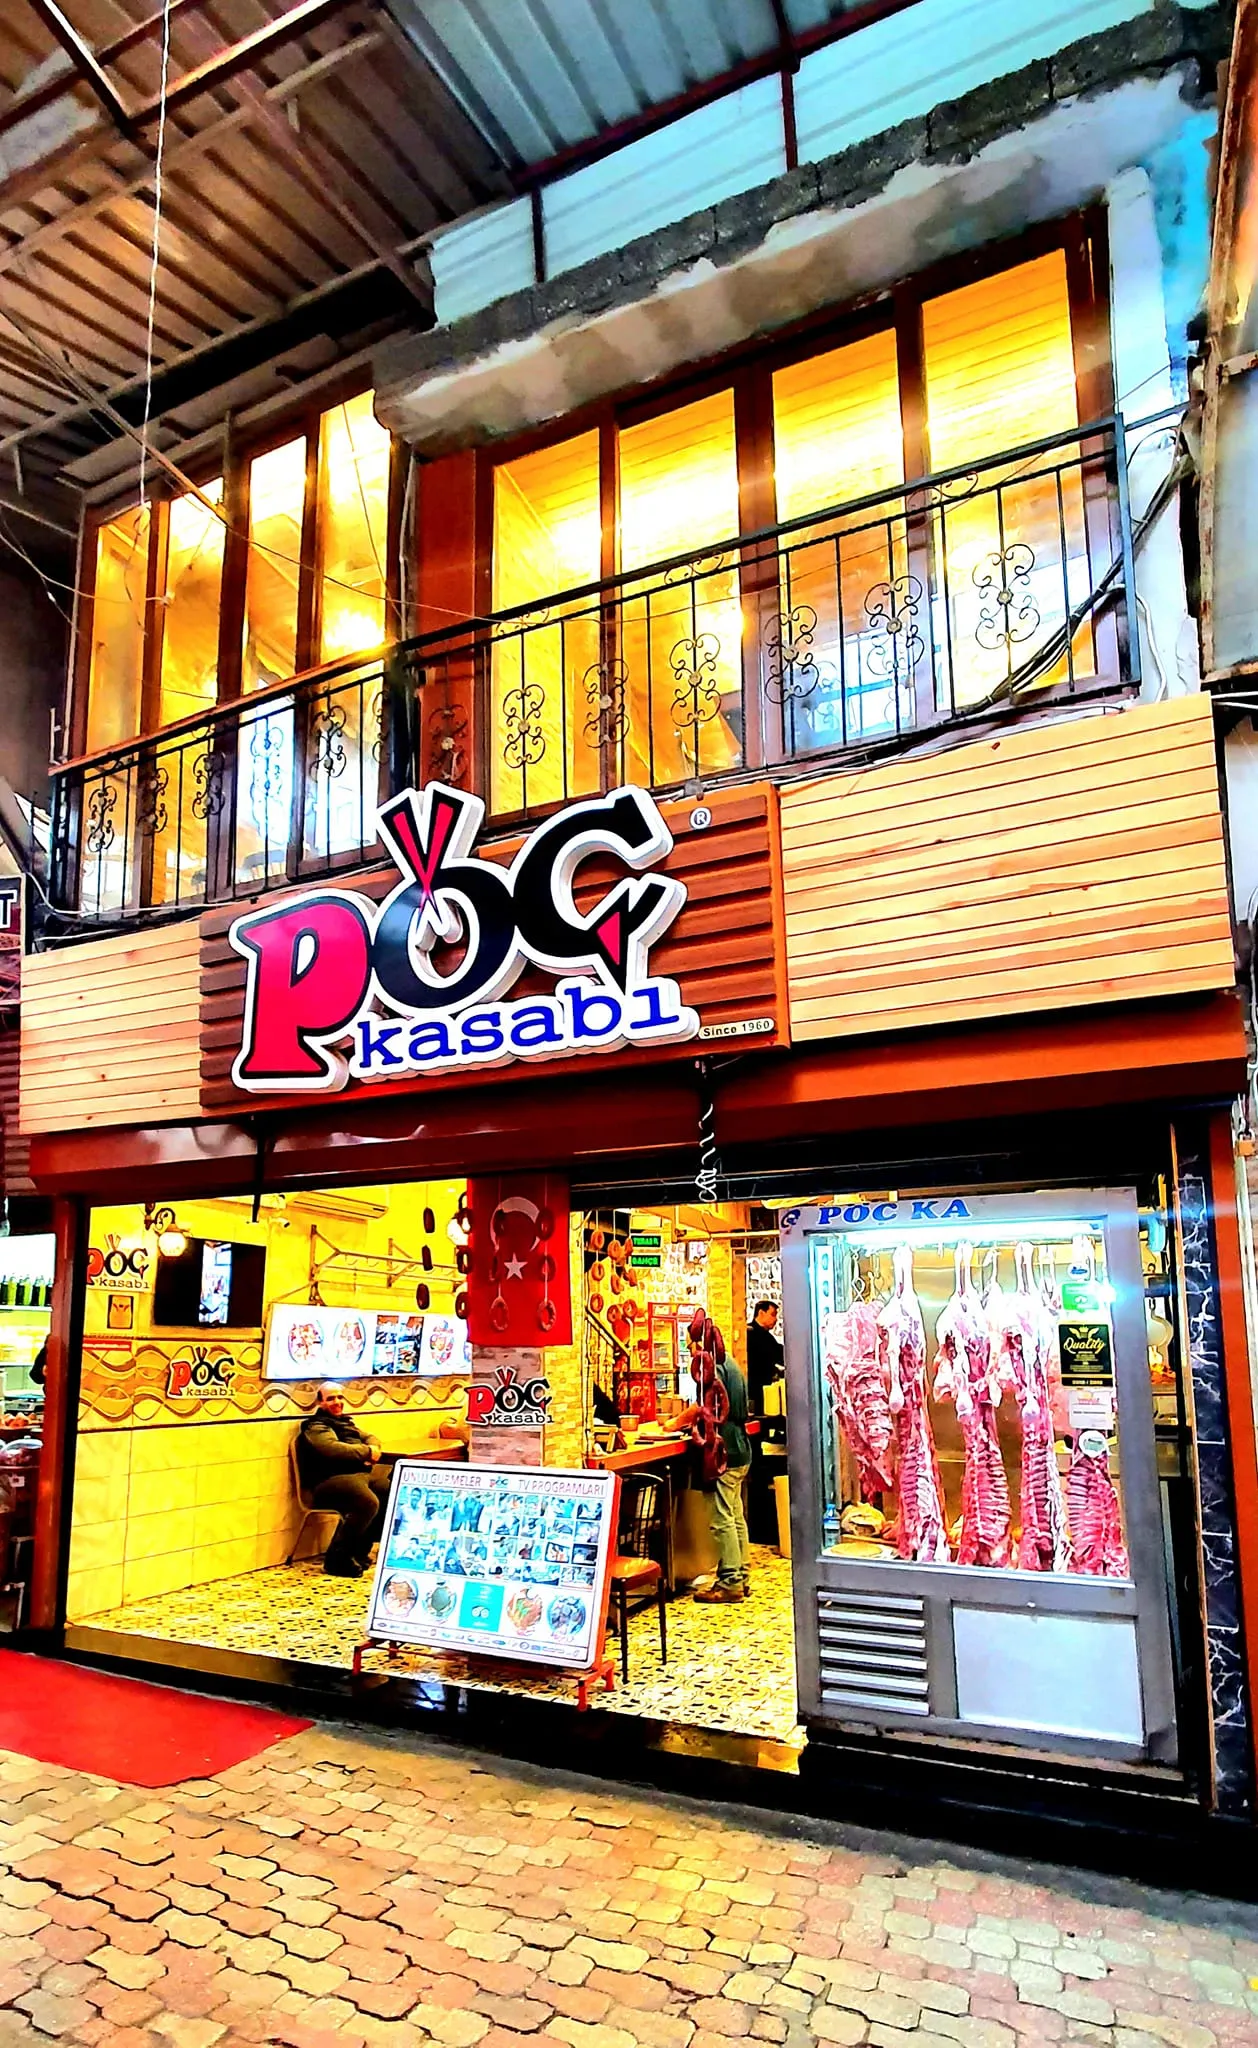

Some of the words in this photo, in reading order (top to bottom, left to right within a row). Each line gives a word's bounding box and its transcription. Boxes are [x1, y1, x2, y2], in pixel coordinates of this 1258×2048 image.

[357, 985, 680, 1069] kasabı
[703, 1026, 737, 1037] Since
[742, 1020, 770, 1032] 1960
[1063, 1337, 1106, 1355] Quality
